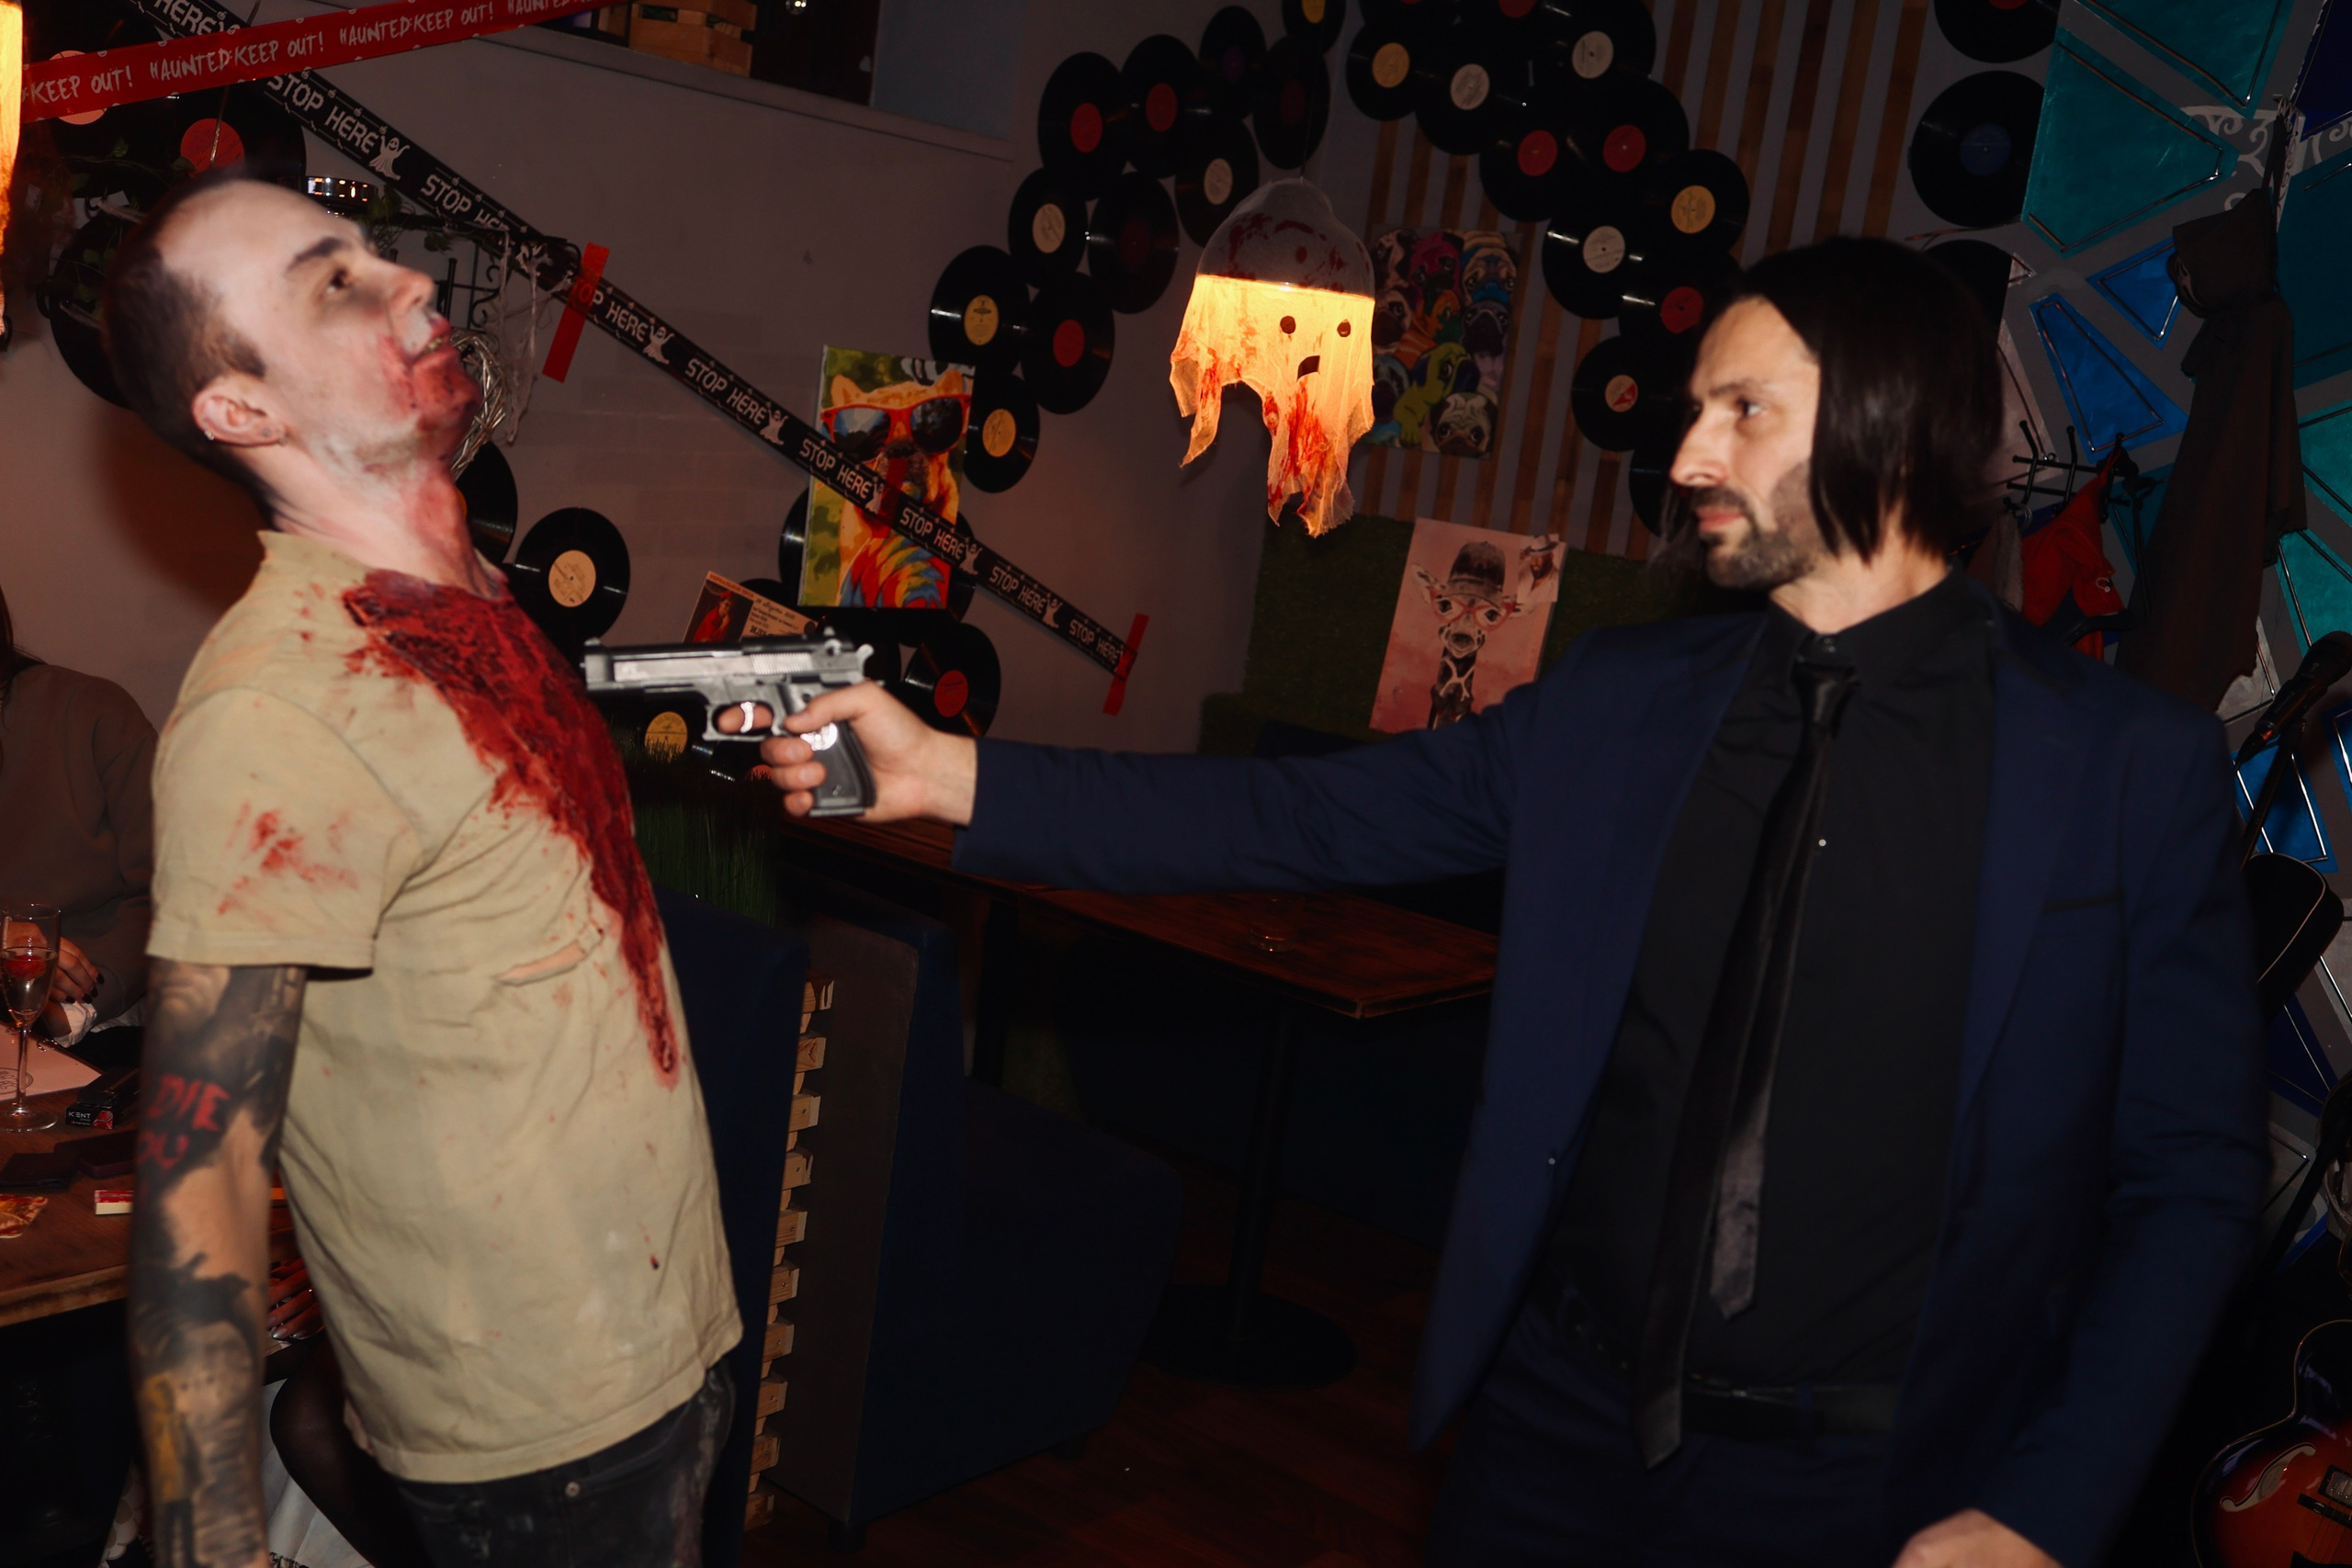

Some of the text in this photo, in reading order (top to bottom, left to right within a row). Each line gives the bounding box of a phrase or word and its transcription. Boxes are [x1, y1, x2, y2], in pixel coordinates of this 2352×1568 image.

[30, 75, 81, 105] KEEP
[91, 65, 132, 94] OUT!
[233, 40, 279, 67] KEEP
[287, 31, 324, 58] OUT!
[413, 8, 454, 33] KEEP
[460, 3, 494, 26] OUT!
[266, 74, 325, 113] STOP
[324, 106, 379, 153] HERE
[420, 174, 472, 215] STOP
[573, 276, 604, 306] TOP
[607, 300, 648, 342] HERE
[684, 357, 728, 393] STOP
[726, 387, 766, 425] HERE
[799, 438, 836, 471] STOP
[836, 464, 873, 500] HERE
[899, 507, 933, 536] STOP
[933, 528, 965, 559] HERE
[989, 566, 1019, 592] STOP
[1017, 588, 1046, 615] HERE
[1069, 619, 1096, 645] STOP
[1095, 637, 1119, 664] HERE
[148, 1073, 230, 1133] DIE
